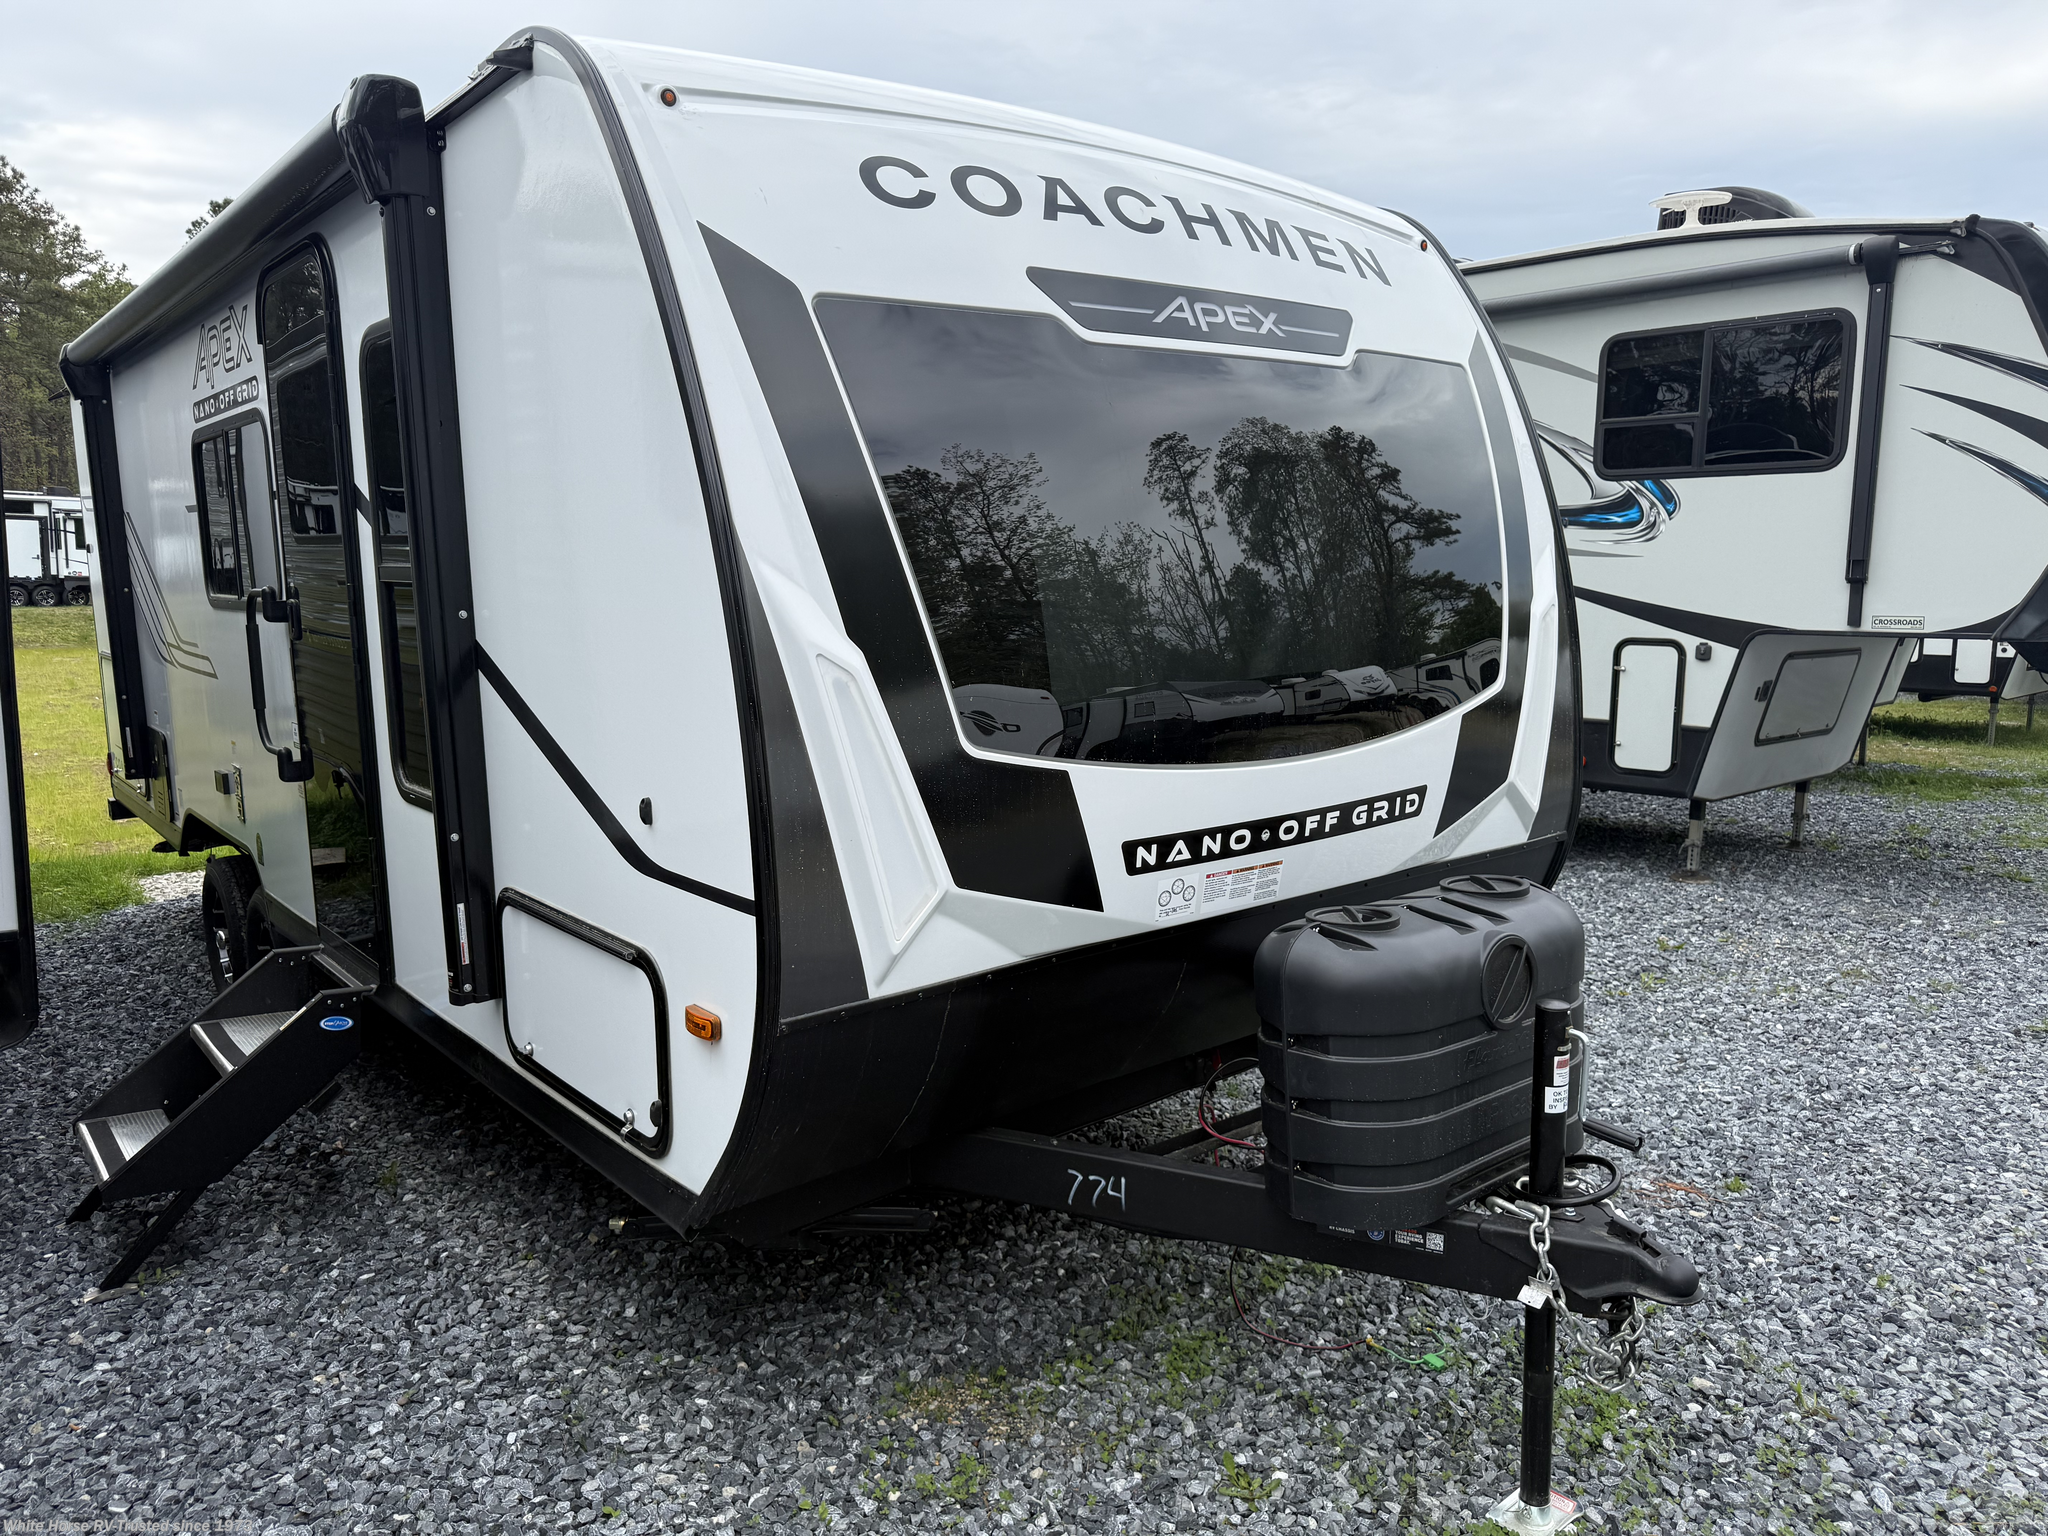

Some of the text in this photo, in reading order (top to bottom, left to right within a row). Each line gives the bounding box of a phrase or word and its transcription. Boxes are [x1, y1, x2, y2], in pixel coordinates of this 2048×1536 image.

[859, 155, 1392, 287] COACHMEN
[1152, 295, 1287, 338] APEX
[193, 304, 253, 390] APEX
[194, 380, 259, 419] NANO OFF GRID
[1873, 618, 1924, 627] CROSSROADS
[1135, 792, 1420, 868] NANO OFF GRID
[1067, 1168, 1126, 1213] 774
